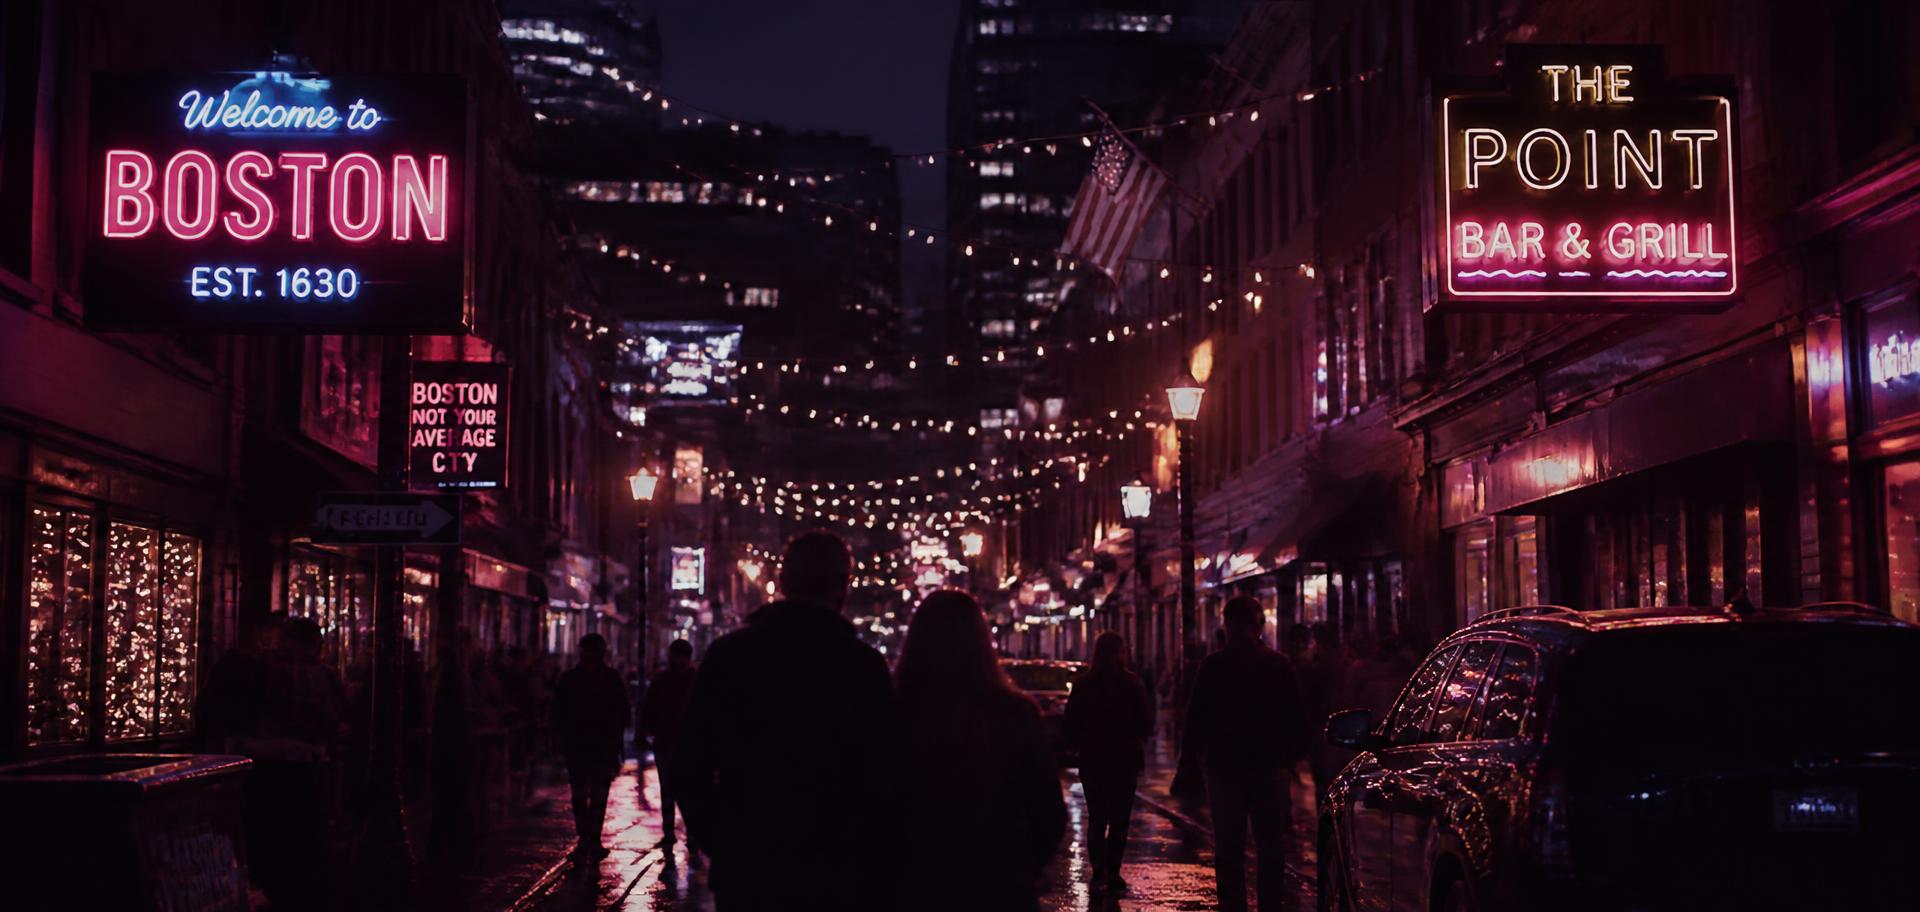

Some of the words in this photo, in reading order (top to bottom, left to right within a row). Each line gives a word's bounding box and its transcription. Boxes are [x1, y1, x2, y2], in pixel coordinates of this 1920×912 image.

[1541, 64, 1634, 102] THE
[178, 90, 340, 130] Welcome
[345, 98, 382, 130] to
[1464, 127, 1719, 190] POINT
[103, 149, 449, 242] BOSTON
[1459, 220, 1546, 259] BAR
[1561, 222, 1592, 259] &
[1607, 221, 1729, 260] GRILL
[190, 266, 263, 298] EST.
[275, 267, 358, 298] 1630
[412, 381, 498, 405] BOSTON
[411, 407, 448, 426] NOT
[453, 407, 497, 426] YOUR
